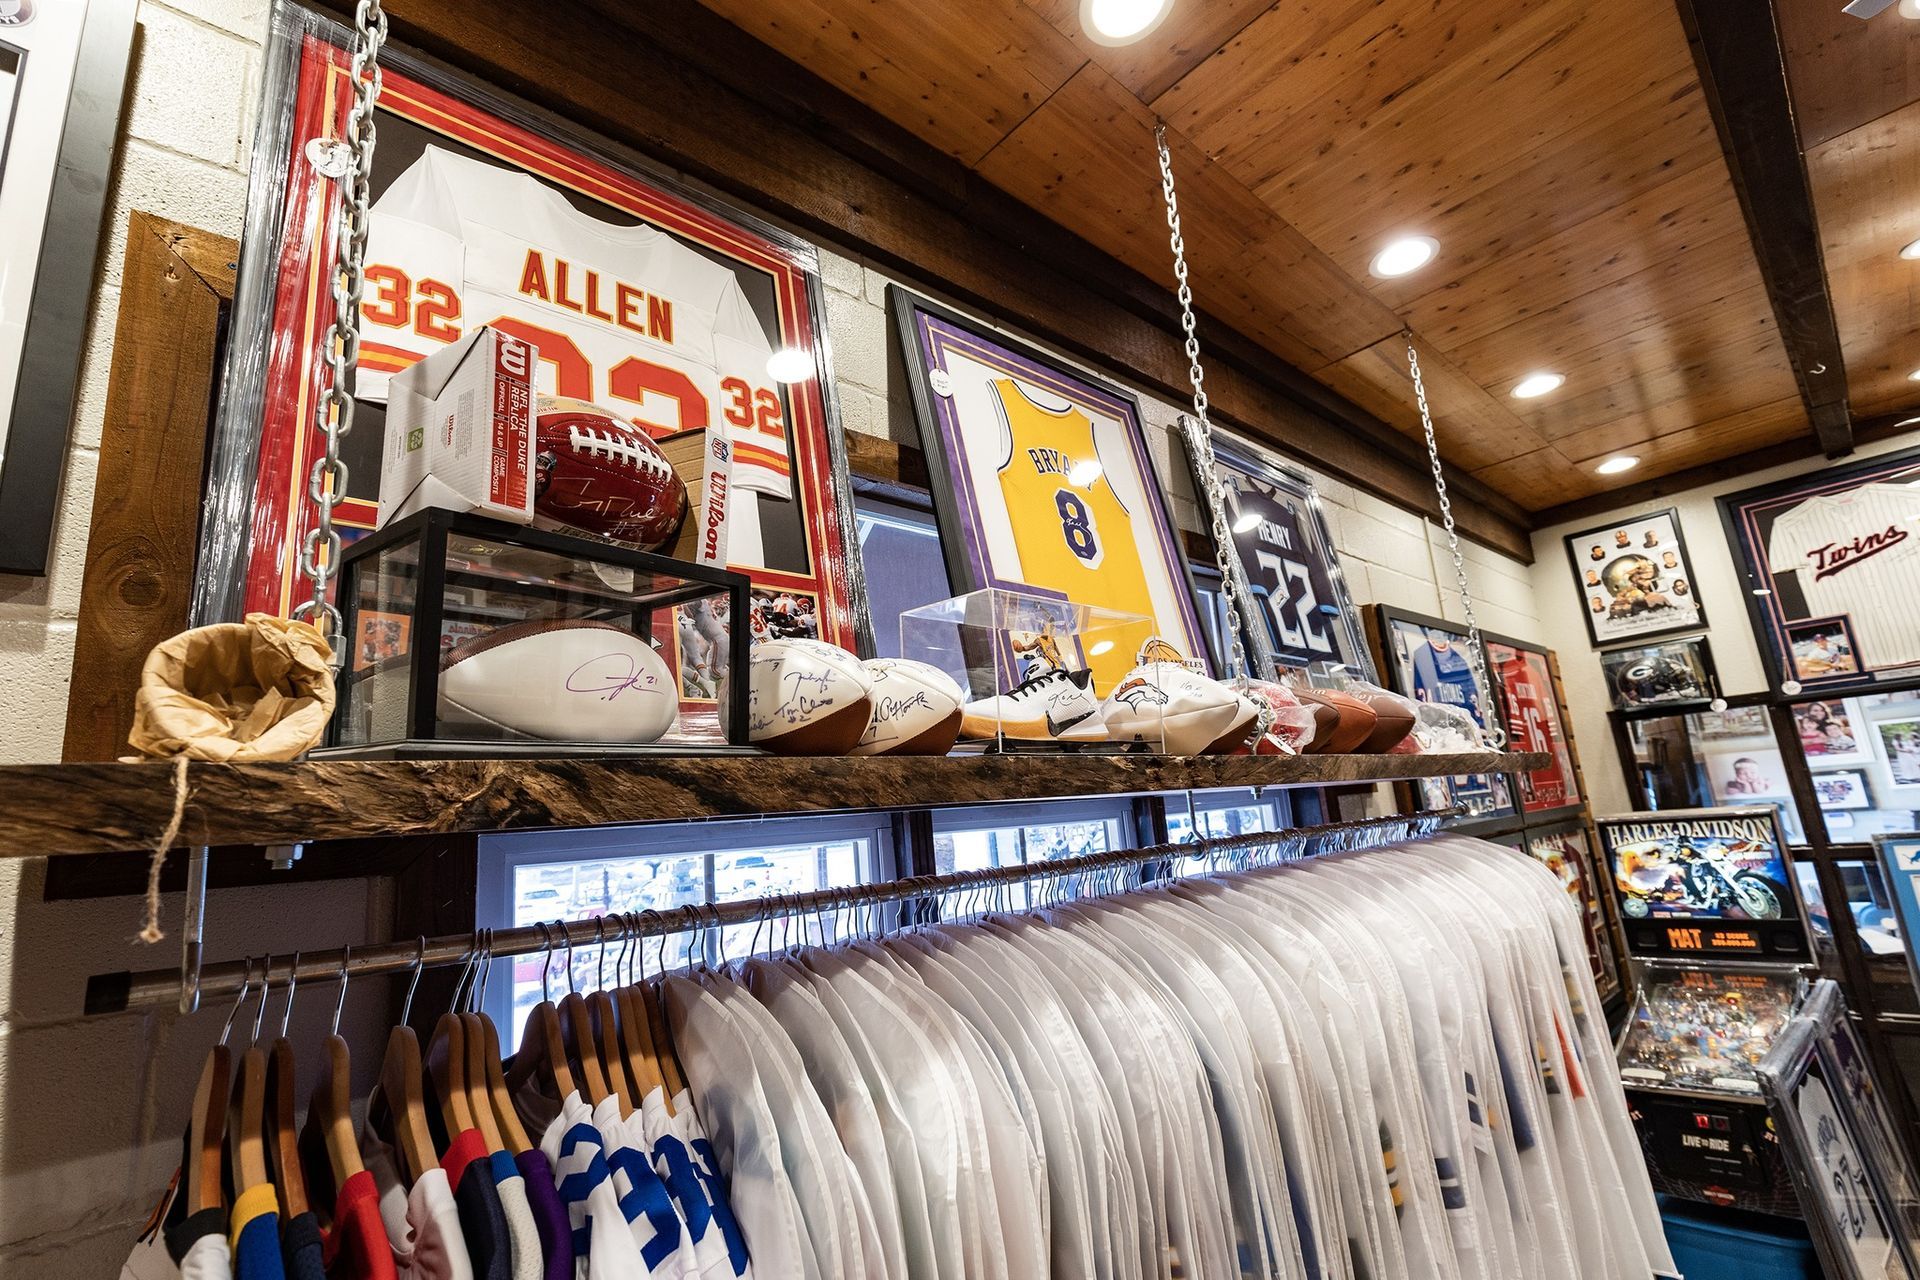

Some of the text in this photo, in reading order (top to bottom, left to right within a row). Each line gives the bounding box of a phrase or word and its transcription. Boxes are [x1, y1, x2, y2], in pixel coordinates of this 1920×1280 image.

[361, 264, 462, 343] 32
[519, 249, 673, 345] ALLEN
[510, 386, 520, 430] REPLICA
[519, 388, 528, 409] NFL
[721, 376, 786, 439] 32
[496, 437, 503, 448] UP
[492, 455, 500, 496] COMPOSITE
[705, 471, 727, 561] Wilson
[1055, 487, 1102, 569] 8
[1257, 518, 1293, 550] HENRY
[1807, 525, 1908, 581] Twins
[1255, 549, 1333, 653] 22
[1606, 816, 1773, 849] HARLEY-DAVIDSON
[1667, 928, 1702, 949] MAT
[1682, 1134, 1702, 1148] LIVE
[1708, 1138, 1730, 1152] RIDE
